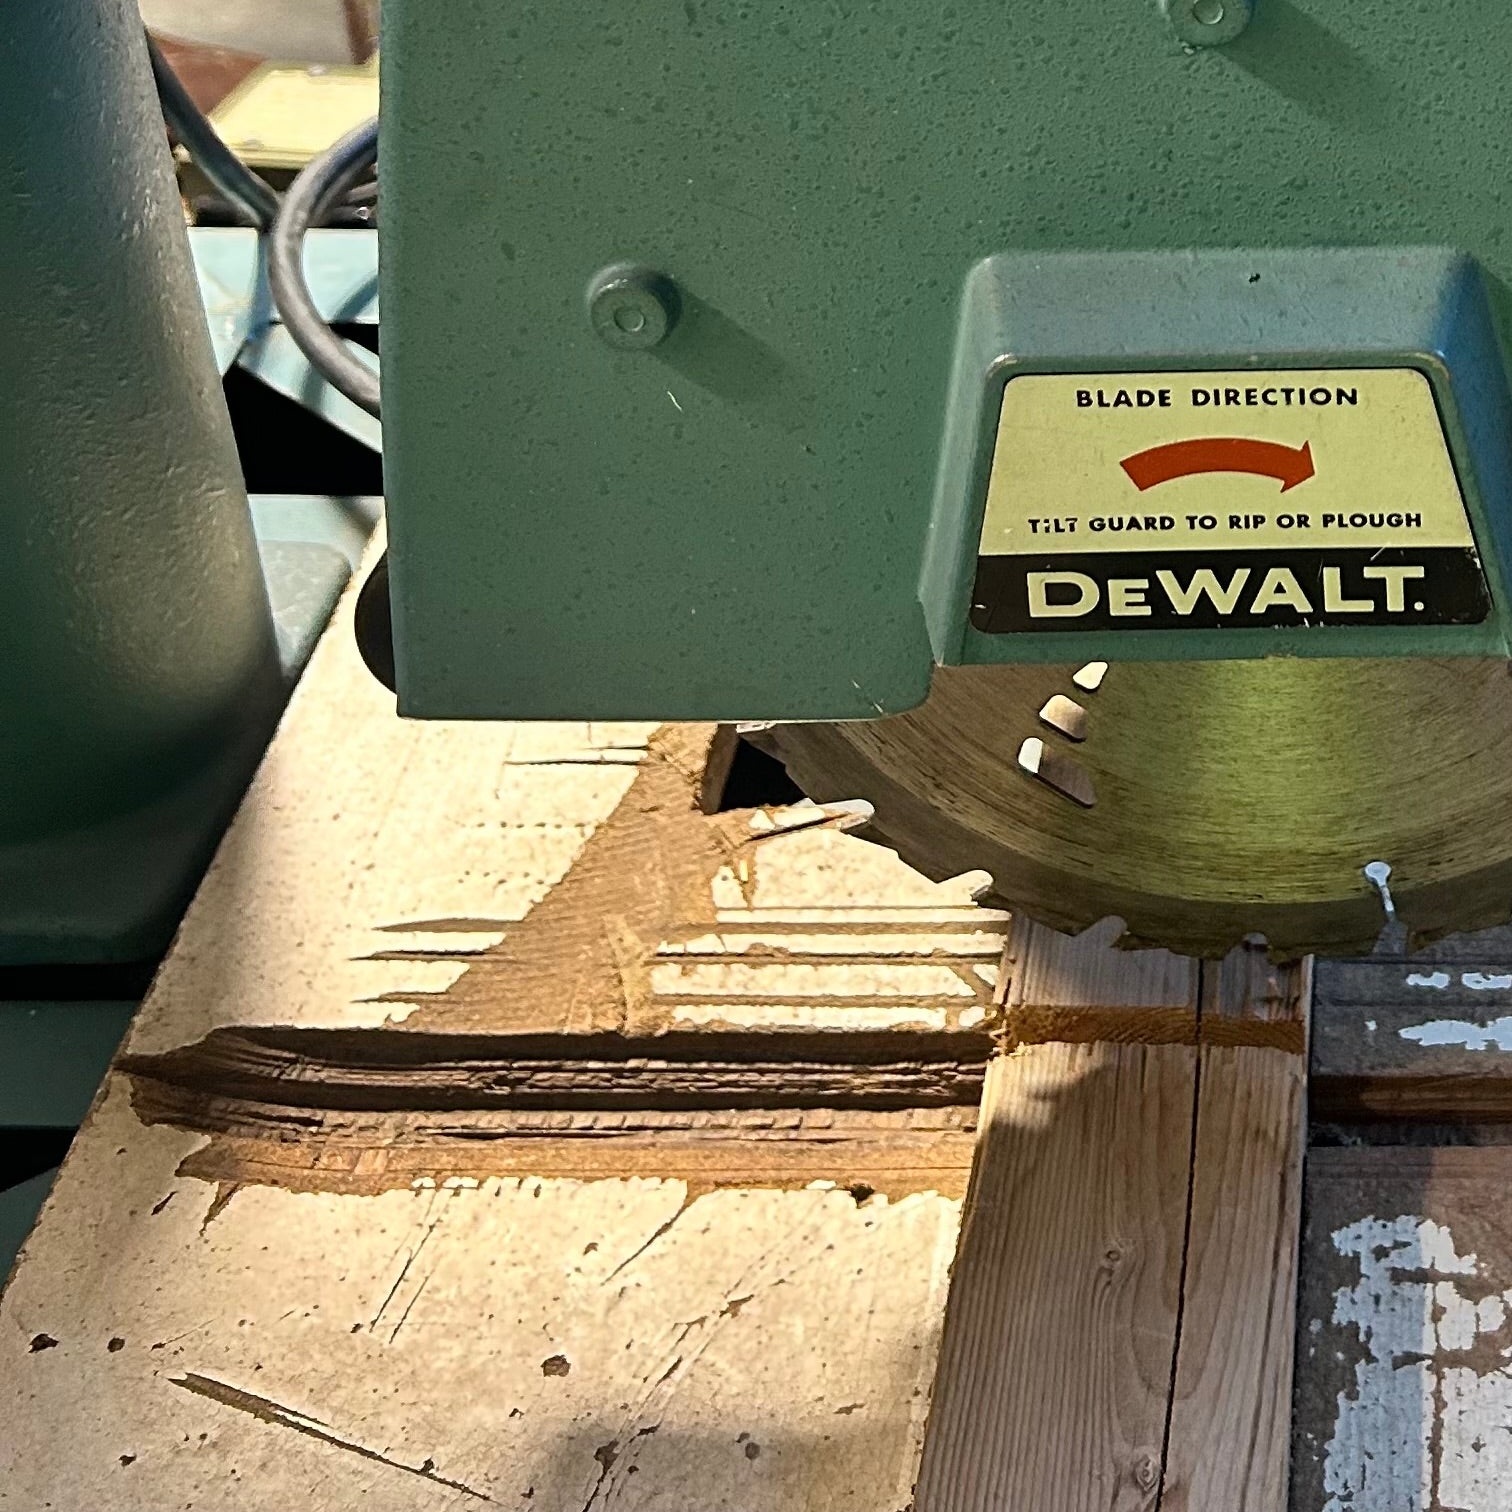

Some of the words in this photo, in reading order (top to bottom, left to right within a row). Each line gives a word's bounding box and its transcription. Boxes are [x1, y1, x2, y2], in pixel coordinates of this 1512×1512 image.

[1076, 388, 1172, 408] BLADE
[1190, 386, 1359, 407] DIRECTION
[1027, 517, 1079, 534] TILT
[1088, 515, 1176, 532] GUARD
[1185, 515, 1218, 531] TO
[1228, 514, 1267, 530] RIP
[1276, 513, 1311, 529] OR
[1321, 512, 1422, 529] PLOUGH
